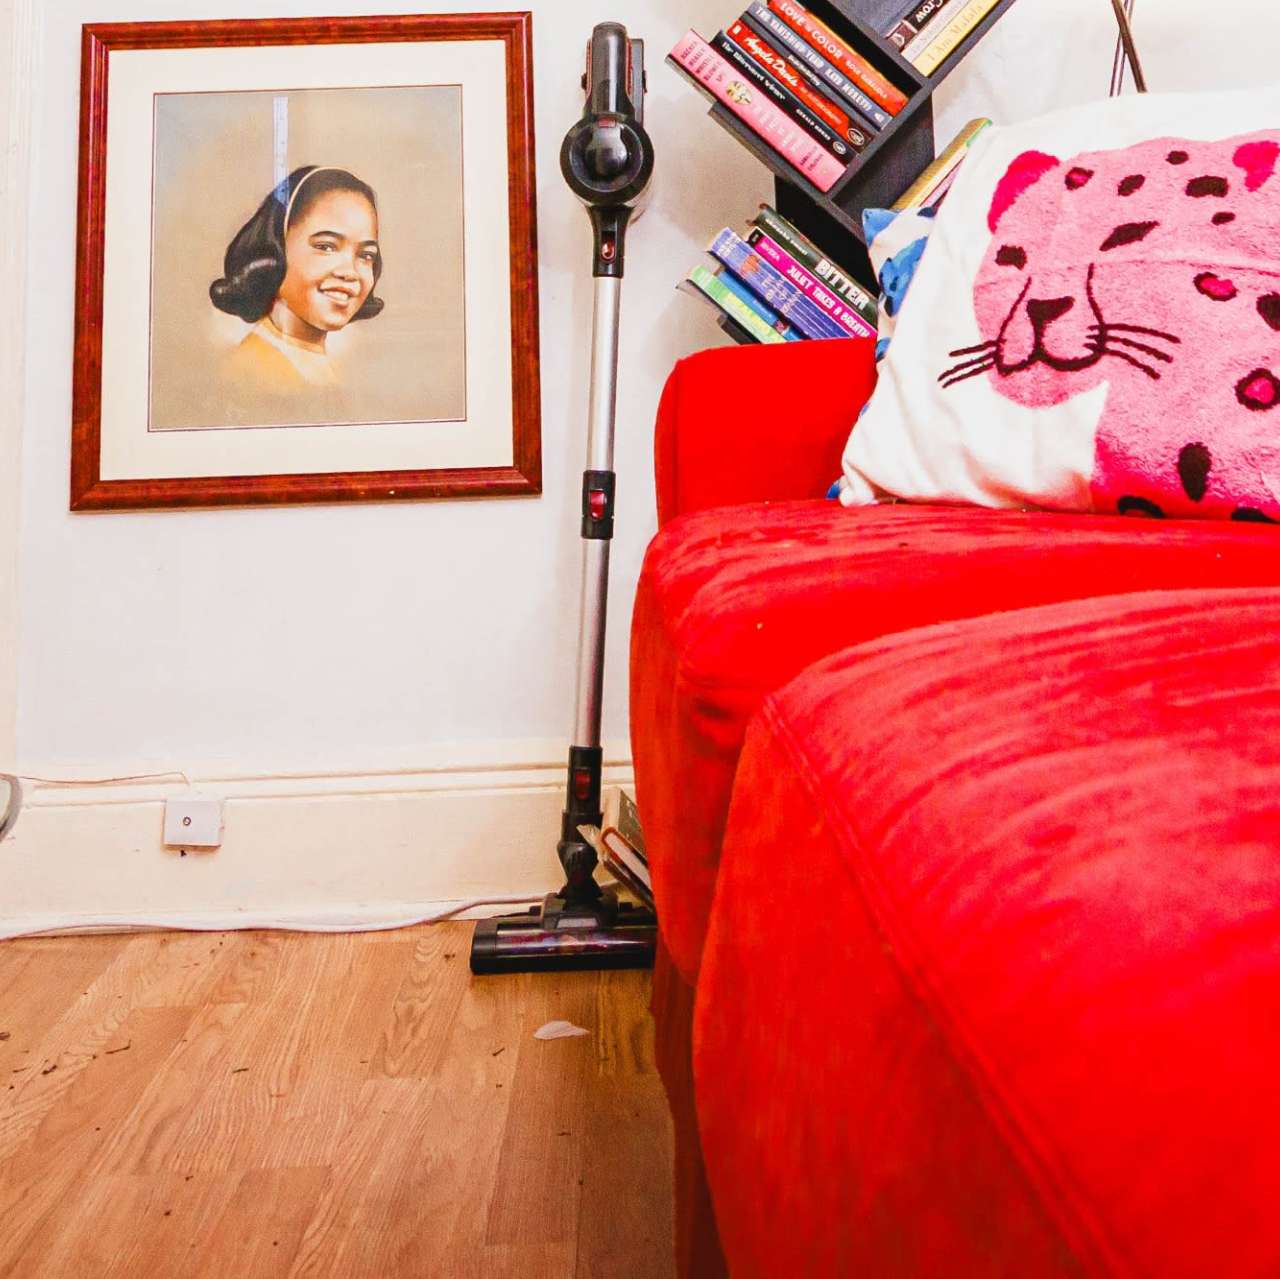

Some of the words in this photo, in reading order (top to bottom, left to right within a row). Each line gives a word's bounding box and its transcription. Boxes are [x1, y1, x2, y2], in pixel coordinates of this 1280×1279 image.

[755, 6, 771, 22] THE
[780, 2, 806, 26] LOVE
[811, 29, 844, 59] COLOR
[744, 37, 774, 64] Angela
[772, 59, 798, 87] Davis
[786, 265, 814, 290] JULIET
[812, 285, 836, 309] TAKES
[839, 311, 871, 337] BREATH
[815, 258, 870, 311] BITTER
